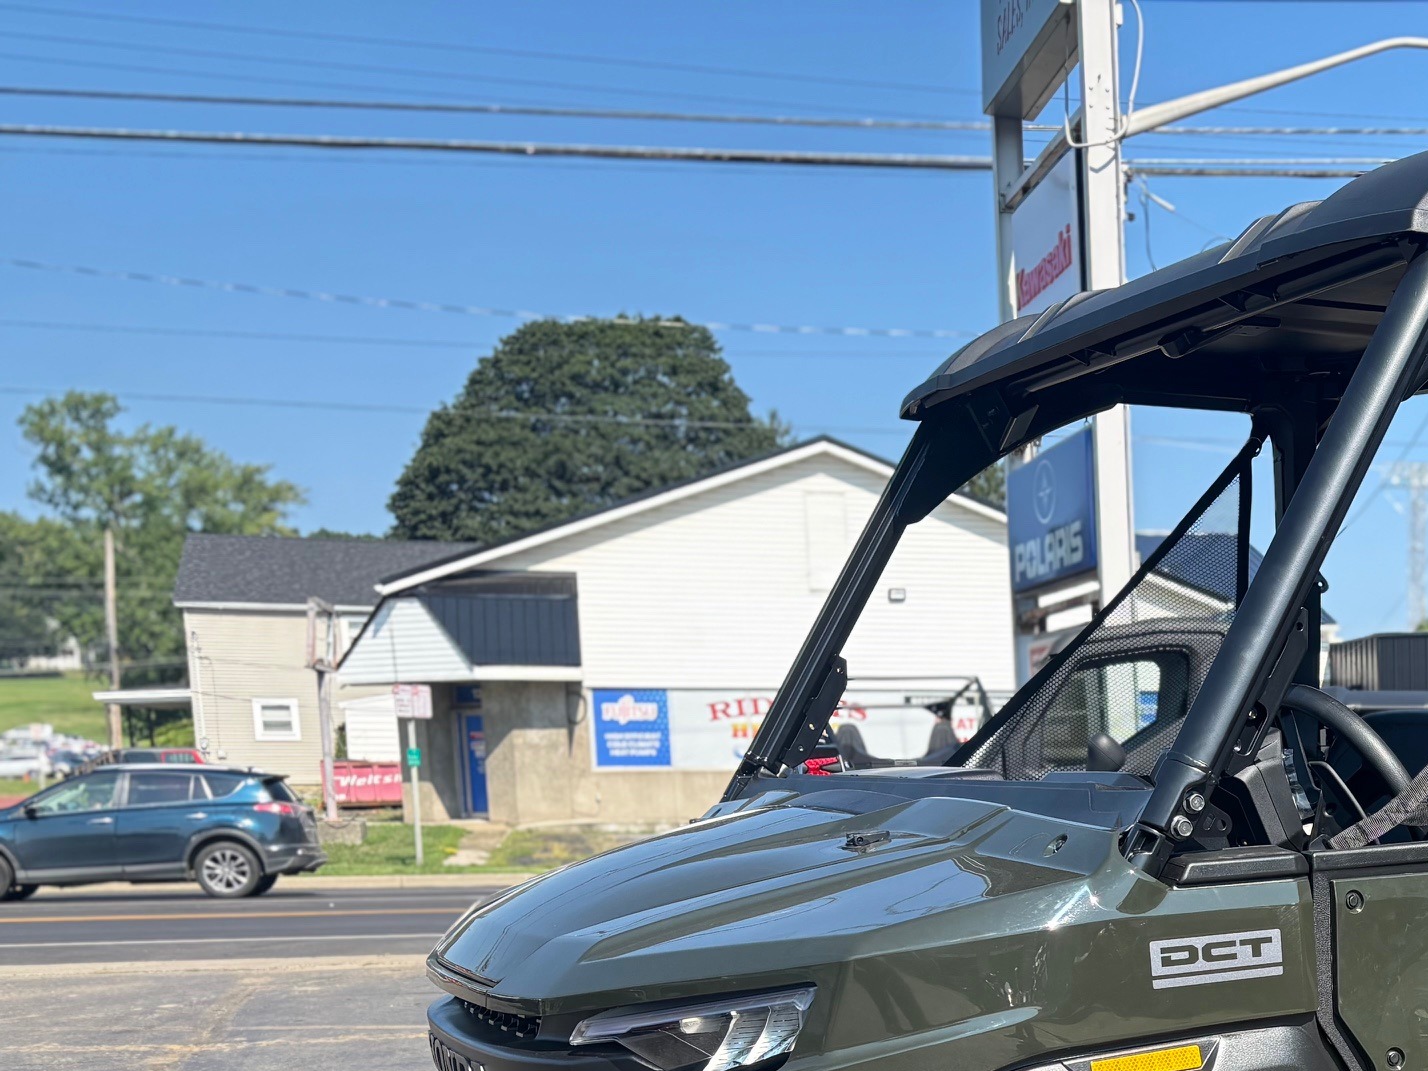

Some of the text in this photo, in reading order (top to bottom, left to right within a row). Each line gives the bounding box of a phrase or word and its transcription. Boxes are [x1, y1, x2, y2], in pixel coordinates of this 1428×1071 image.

[1016, 223, 1072, 311] Kawasaki
[1015, 519, 1084, 584] POLARIS
[1160, 936, 1273, 968] DCT
